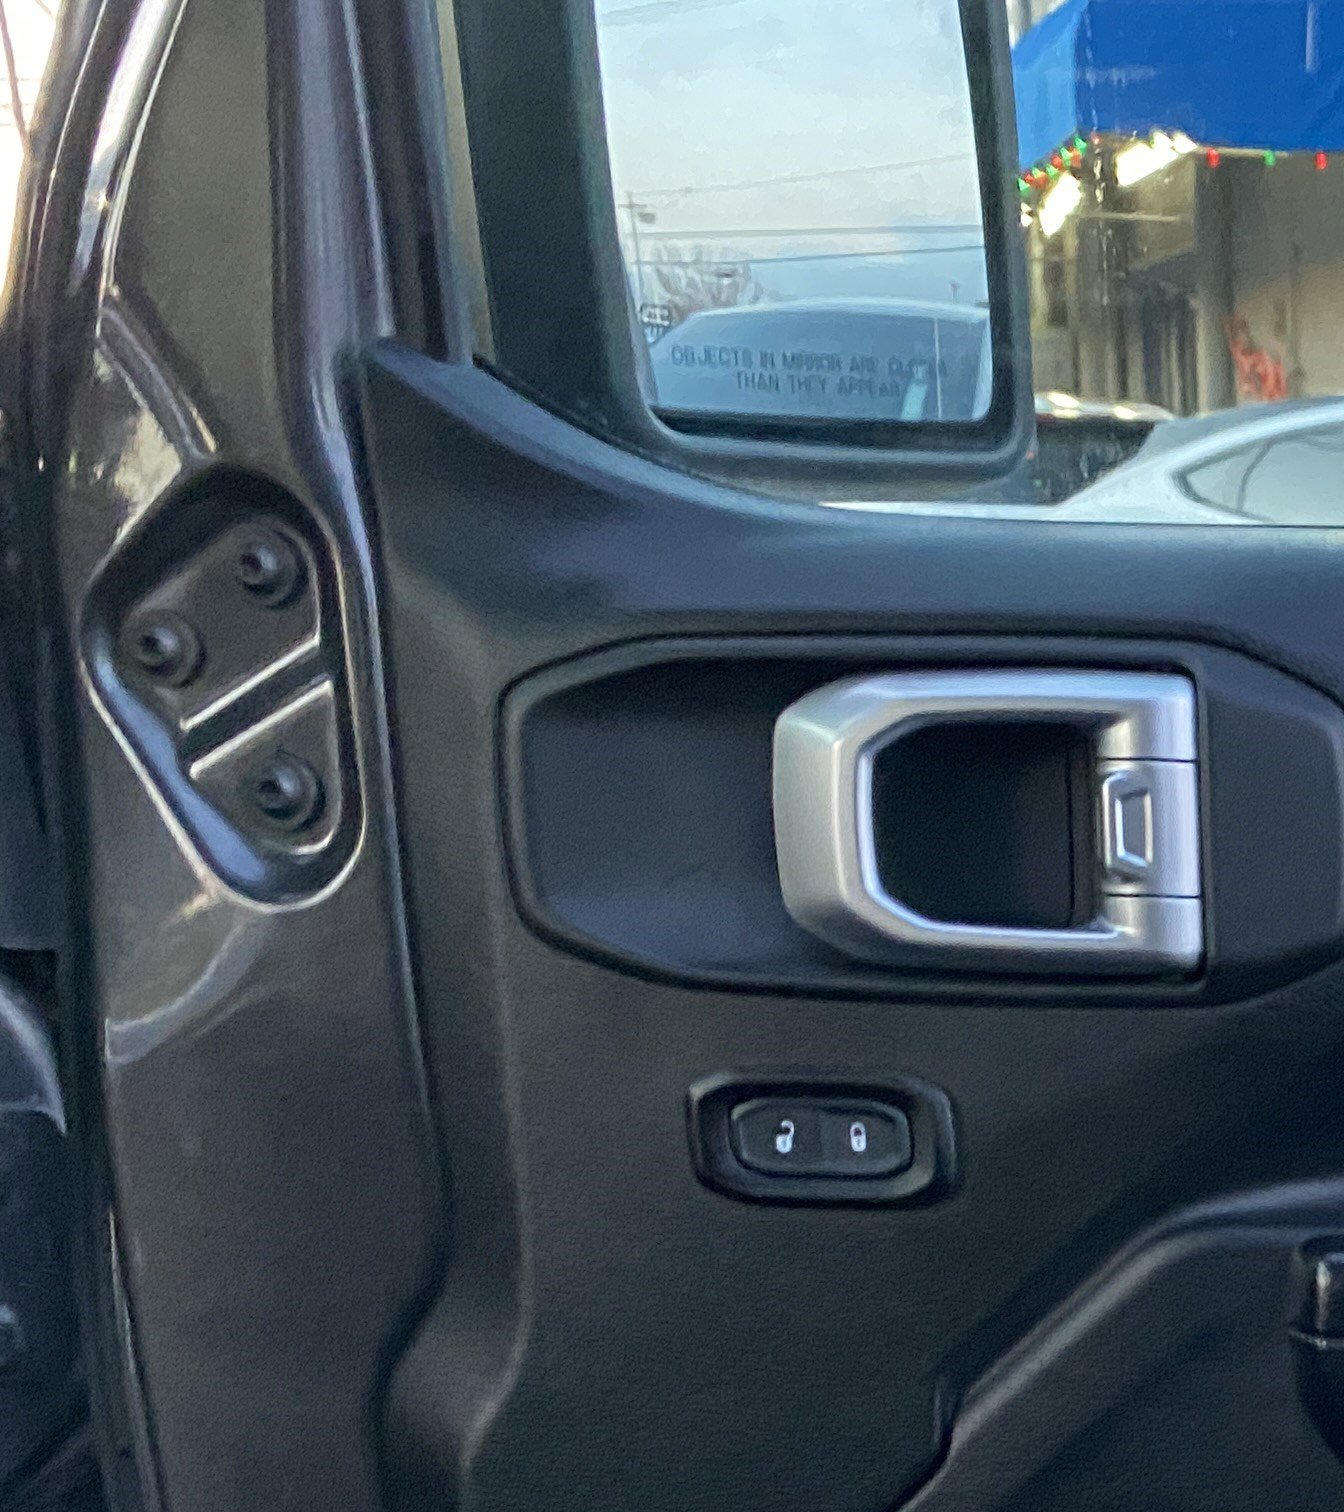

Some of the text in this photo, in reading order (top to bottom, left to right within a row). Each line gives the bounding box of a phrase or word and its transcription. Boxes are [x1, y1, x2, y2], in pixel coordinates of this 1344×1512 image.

[671, 345, 754, 368] OBJECTS
[759, 350, 776, 369] IN
[781, 351, 842, 371] MIRROR
[736, 370, 780, 392] THAN
[787, 373, 827, 395] THEY
